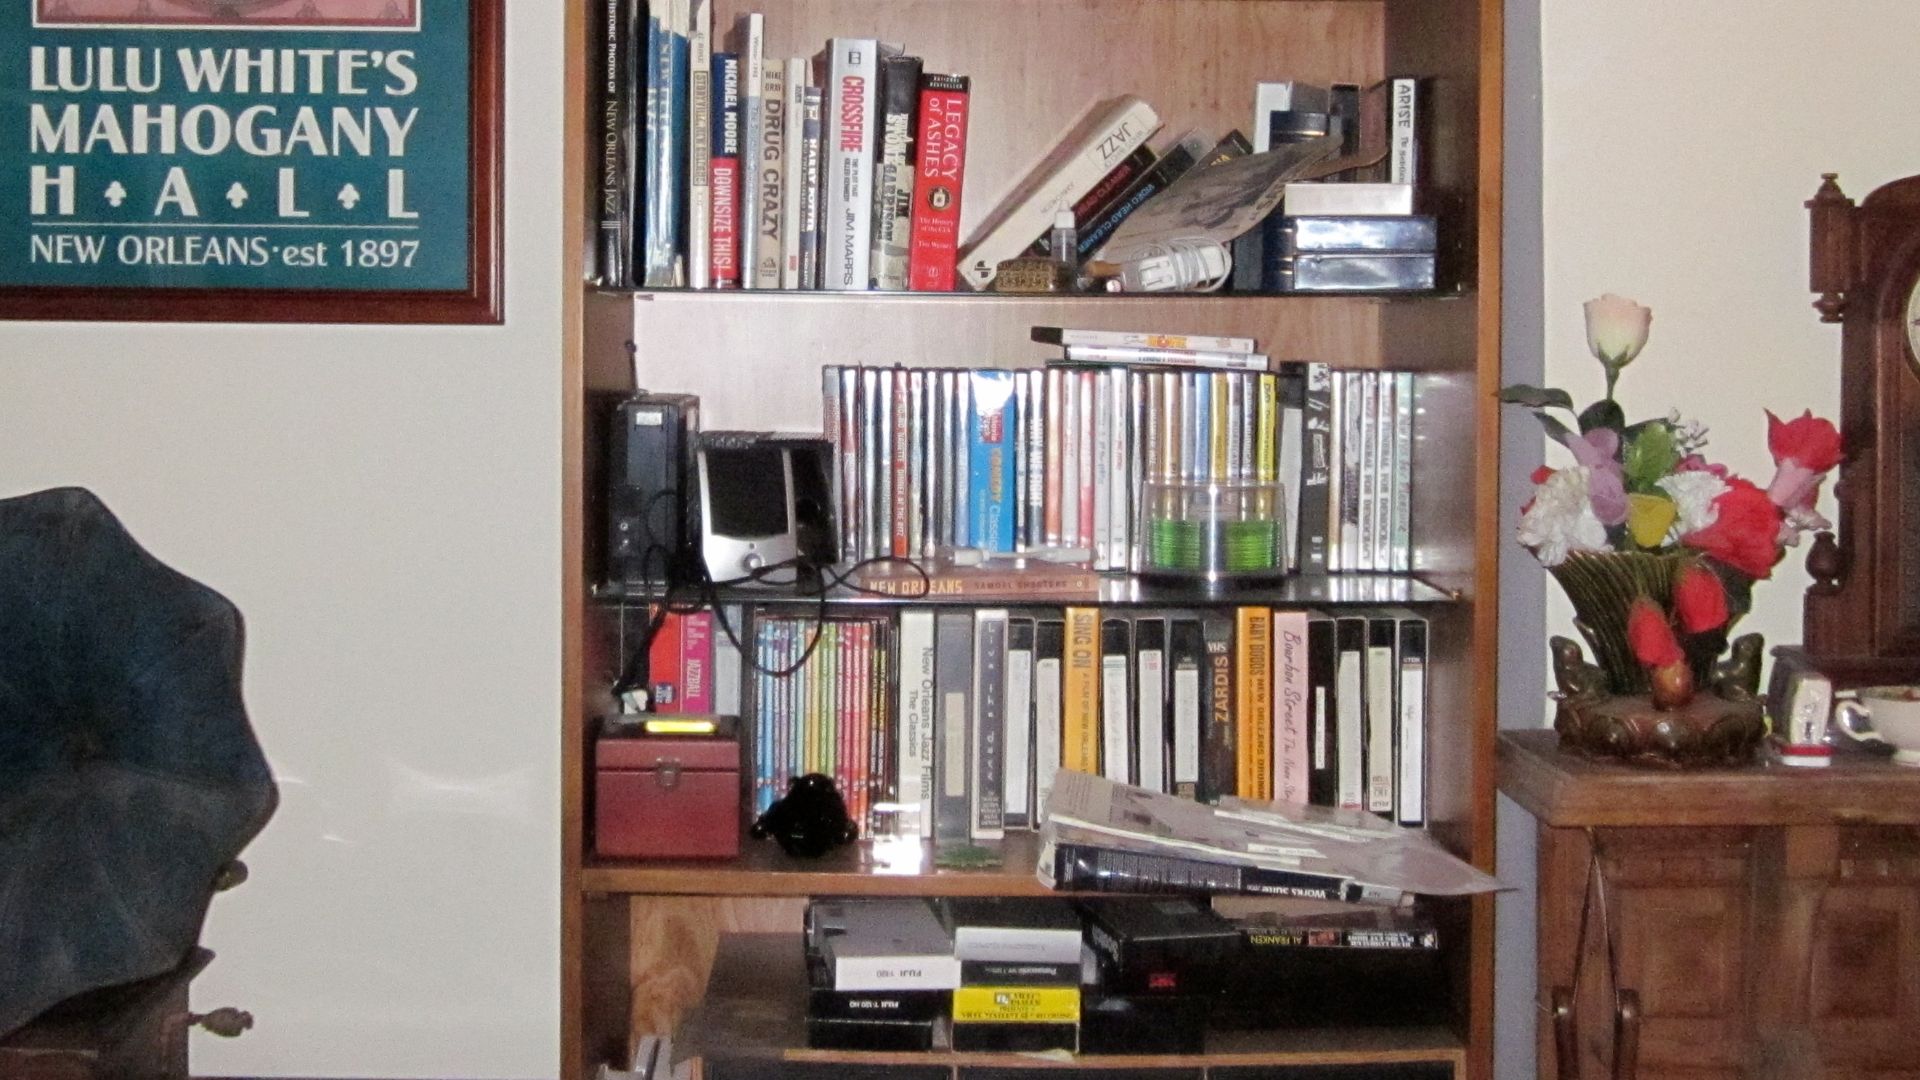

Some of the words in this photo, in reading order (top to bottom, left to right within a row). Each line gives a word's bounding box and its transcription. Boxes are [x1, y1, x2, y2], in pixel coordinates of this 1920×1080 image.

[31, 46, 161, 92] LULU
[177, 47, 419, 96] WHITE'S
[607, 43, 617, 79] PHOTOS
[724, 58, 738, 109] MICHAEL
[605, 100, 618, 130] NEW
[841, 75, 865, 153] CROSSFIRE
[928, 97, 942, 114] of
[1398, 84, 1411, 128] ARISE
[31, 104, 419, 157] MAHOGANY
[723, 111, 738, 154] MOORE
[764, 98, 781, 161] DRUG
[943, 99, 963, 182] LEGACY
[1095, 122, 1132, 160] JAZZ
[605, 132, 618, 185] ORLEANS
[807, 137, 818, 184] HARRY
[924, 118, 941, 179] ASHES
[604, 188, 618, 215] JAZZ
[713, 167, 732, 233] DOWNSIZE
[762, 168, 780, 241] CRAZY
[806, 187, 817, 232] POTTER
[1131, 183, 1156, 206] VIDEO
[845, 207, 857, 232] JIM
[1111, 202, 1135, 225] HEAD
[31, 234, 105, 264] NEW
[118, 237, 268, 266] ORLEANS
[282, 241, 328, 267] est
[341, 239, 420, 268] 1897
[713, 236, 731, 270] THIS!
[1078, 220, 1114, 254] CLEANER
[843, 234, 857, 285] MARRS
[989, 504, 1001, 552] Classics
[869, 580, 896, 595] NEW
[901, 579, 964, 595] ORLEANS
[1073, 614, 1092, 646] SING
[1207, 641, 1227, 652] VHS
[1249, 616, 1266, 641] BABY
[920, 647, 933, 674] New
[1073, 649, 1092, 669] ON
[1249, 643, 1266, 676] DODDS
[1283, 630, 1302, 684] Bourbon
[686, 658, 701, 700] JAZZBALL
[1214, 656, 1229, 722] ZARDIS
[1256, 678, 1265, 703] NEW
[908, 690, 919, 711] The
[920, 679, 933, 729] Orleans
[1284, 687, 1302, 736] Street
[908, 712, 919, 758] Classics
[920, 732, 933, 762] Jazz
[1256, 706, 1265, 755] ORLEANS
[920, 765, 932, 800] Films
[1291, 887, 1326, 899] Works
[1250, 935, 1290, 945] FRANKEN
[900, 969, 922, 977] FUJI
[881, 1000, 899, 1009] FUJI
